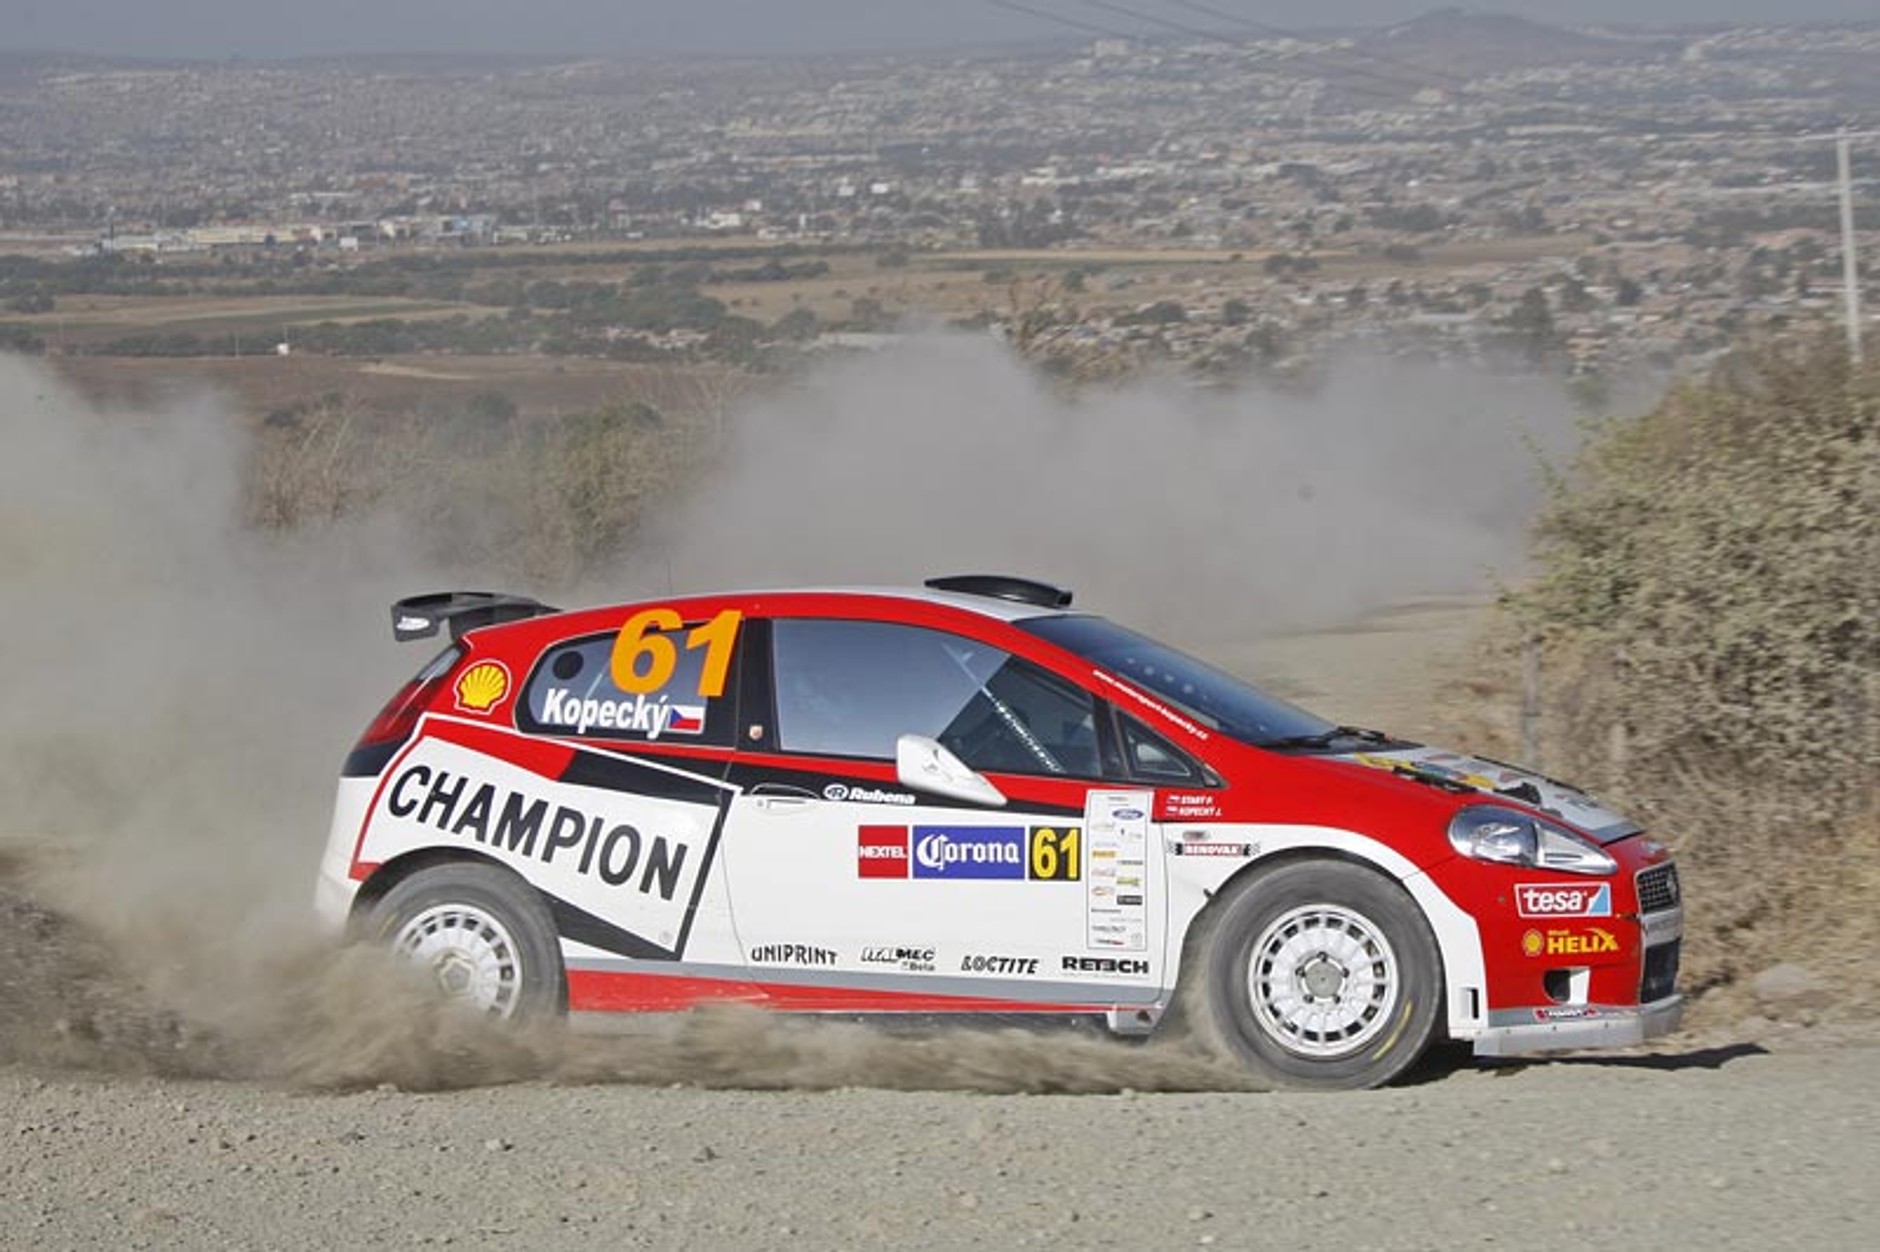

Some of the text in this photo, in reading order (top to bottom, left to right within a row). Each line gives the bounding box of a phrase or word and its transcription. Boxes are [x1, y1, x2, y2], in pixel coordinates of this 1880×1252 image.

[610, 609, 742, 697] 61
[542, 688, 668, 740] Kopecký
[849, 787, 915, 804] Rubena
[388, 765, 688, 901] CHAMPION
[859, 846, 907, 859] NEXTEL
[916, 834, 1020, 871] Corona
[1032, 828, 1079, 878] 61
[1523, 889, 1582, 912] tesa
[1547, 930, 1619, 954] HELIX
[751, 945, 837, 965] UNIPRINT
[961, 956, 1039, 974] LOCTITE
